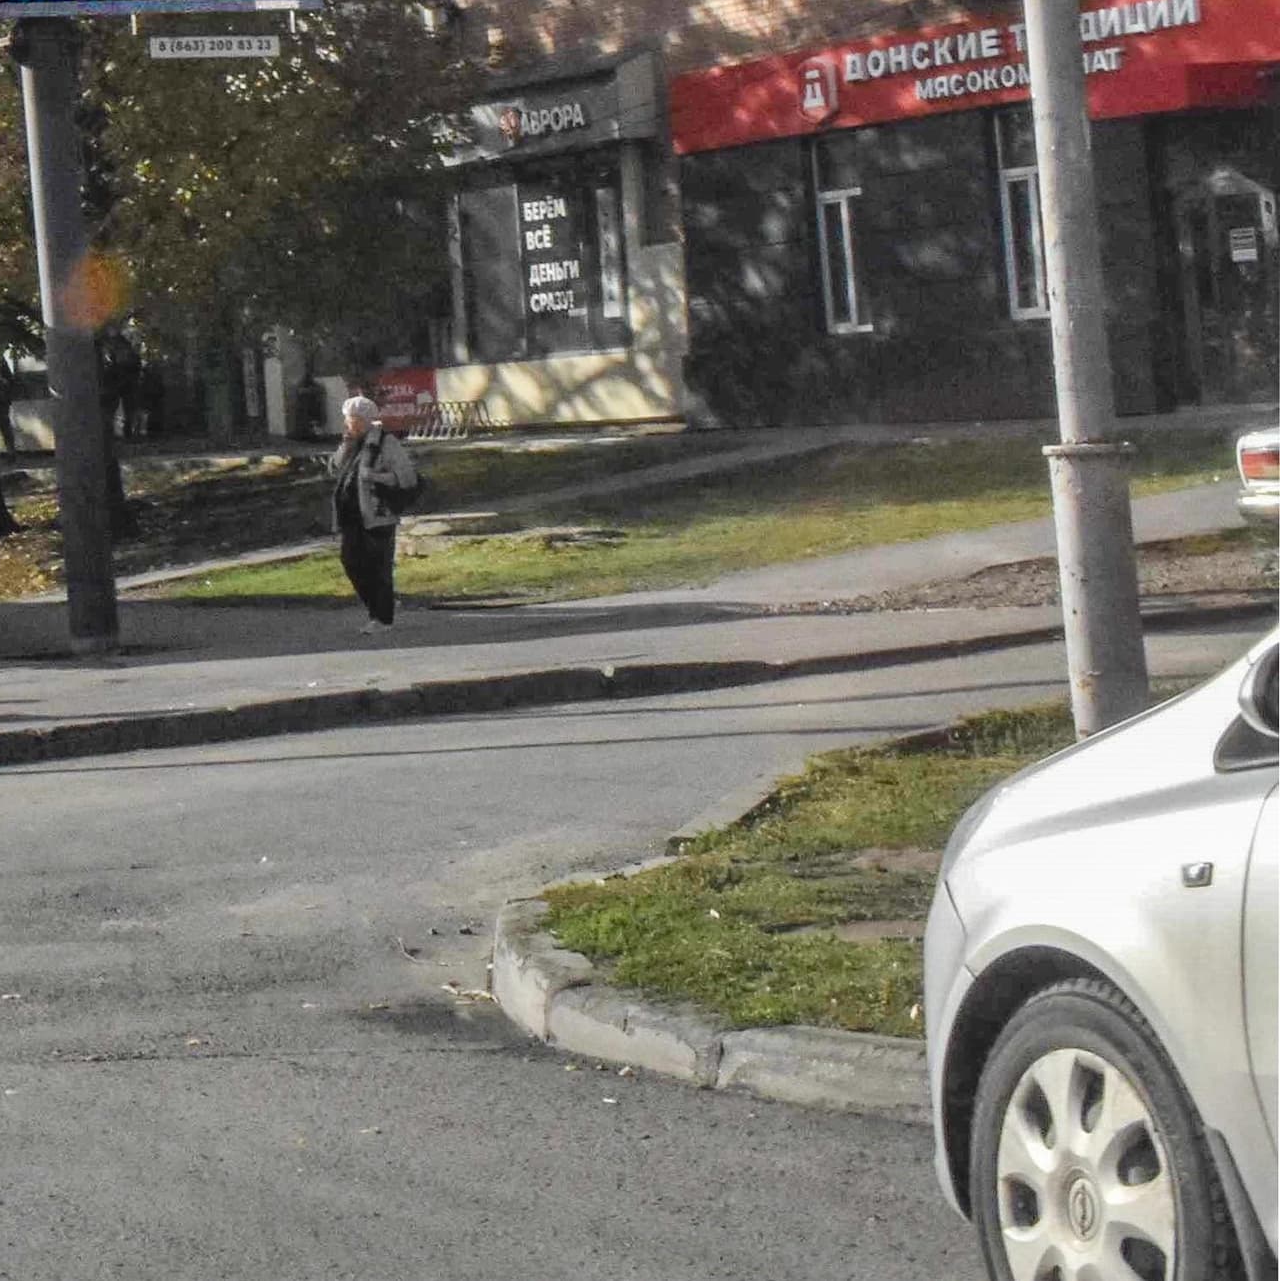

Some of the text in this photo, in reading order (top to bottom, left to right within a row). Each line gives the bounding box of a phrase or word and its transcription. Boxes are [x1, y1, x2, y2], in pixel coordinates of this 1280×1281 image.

[257, 39, 271, 51] 23
[845, 28, 1001, 82] ДОНСКИЕ
[915, 47, 1122, 100] МЯСОКОМАТ
[520, 103, 585, 135] АВРОРА
[523, 195, 566, 221] БЕРЁМ
[525, 224, 553, 250] ВСЁ
[529, 260, 580, 287] ДЕНЬГИ
[530, 290, 574, 313] СРАЗУ!
